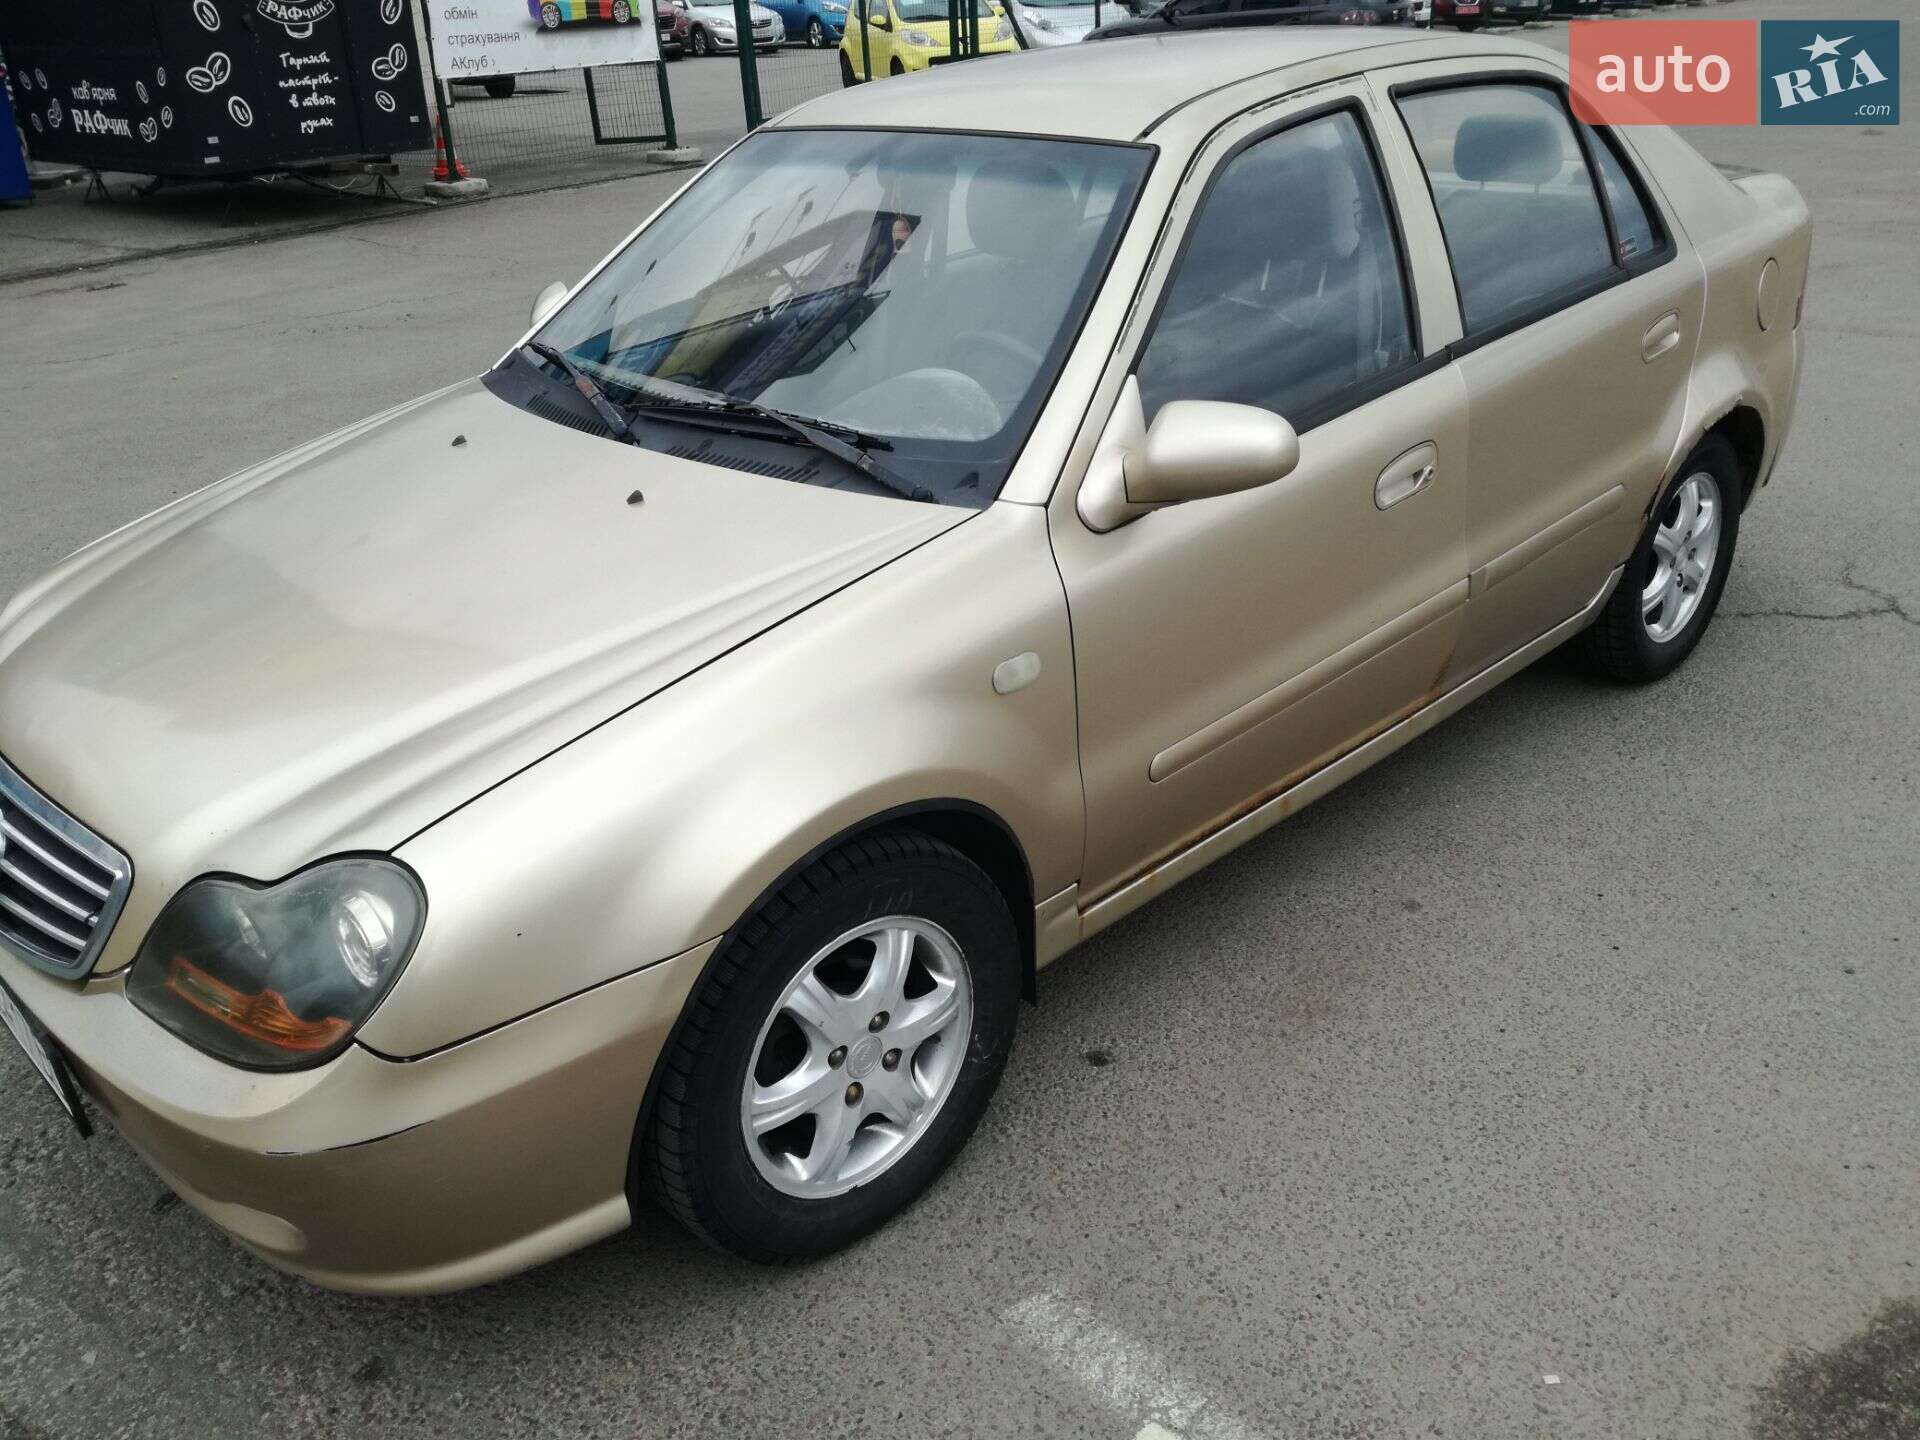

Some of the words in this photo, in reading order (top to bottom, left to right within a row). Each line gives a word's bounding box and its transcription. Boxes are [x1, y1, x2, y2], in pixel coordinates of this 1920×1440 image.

[444, 6, 478, 20] обмін
[447, 32, 521, 48] страхування
[279, 51, 330, 70] Гарний
[451, 55, 488, 71] АКлуб
[289, 93, 299, 108] в
[302, 92, 336, 106] твоїх
[300, 117, 333, 133] руках
